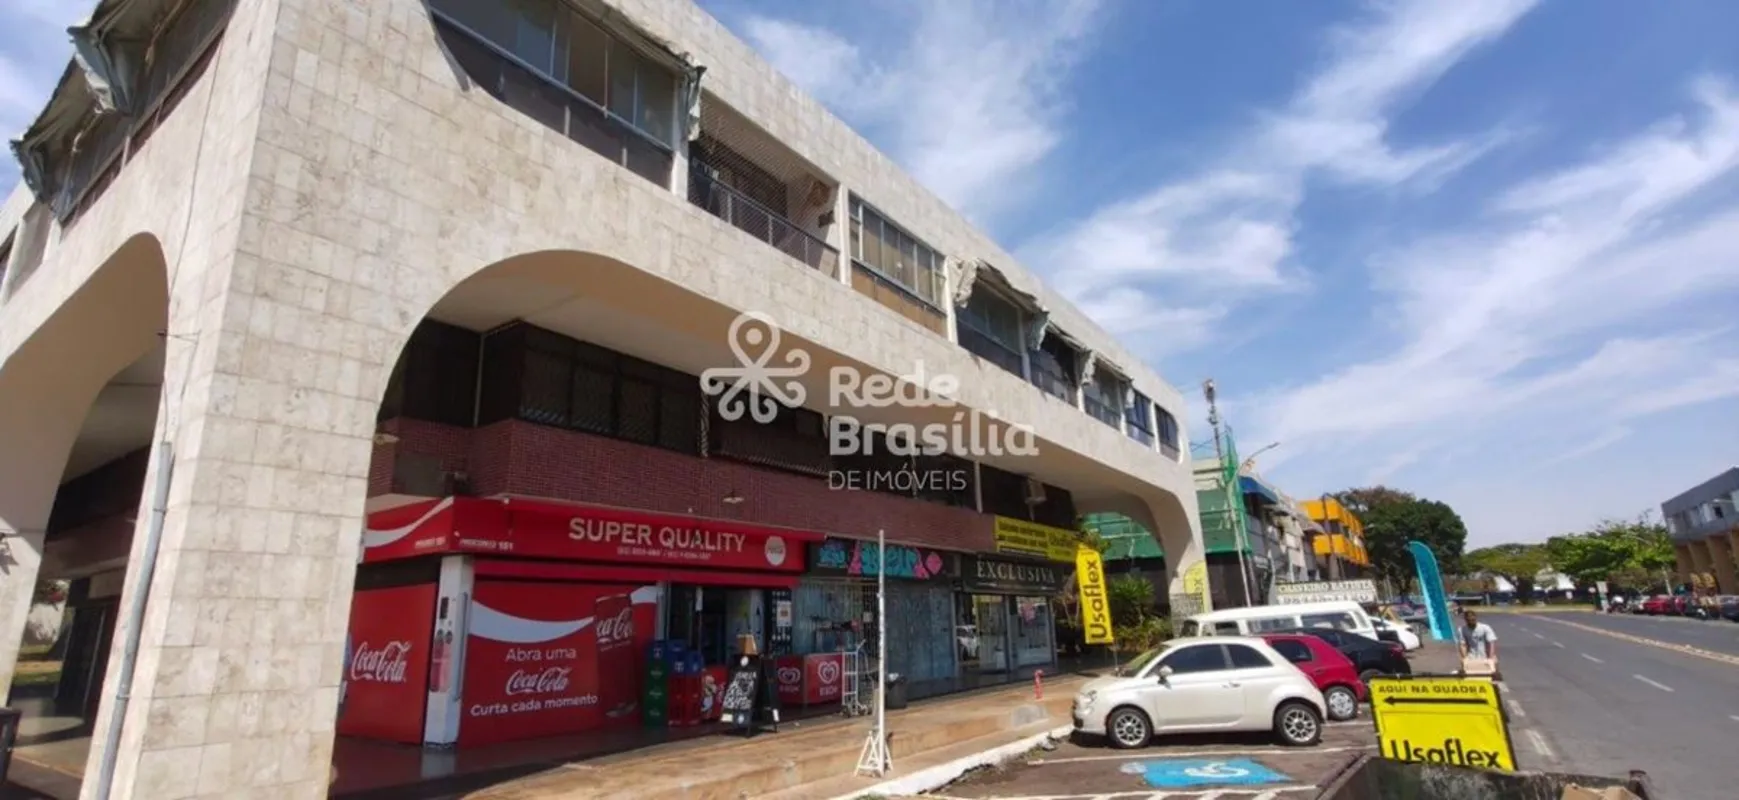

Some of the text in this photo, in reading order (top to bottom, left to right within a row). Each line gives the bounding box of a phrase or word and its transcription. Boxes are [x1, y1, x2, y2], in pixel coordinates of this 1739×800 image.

[568, 516, 653, 545] SUPER
[658, 526, 747, 553] QUALITY
[1083, 560, 1108, 639] Usaflex
[505, 647, 577, 661] Abra uma
[1378, 684, 1488, 694] AQUI NA QUADRA
[470, 693, 598, 717] Curta cada momento
[1390, 738, 1502, 769] Usaflex
